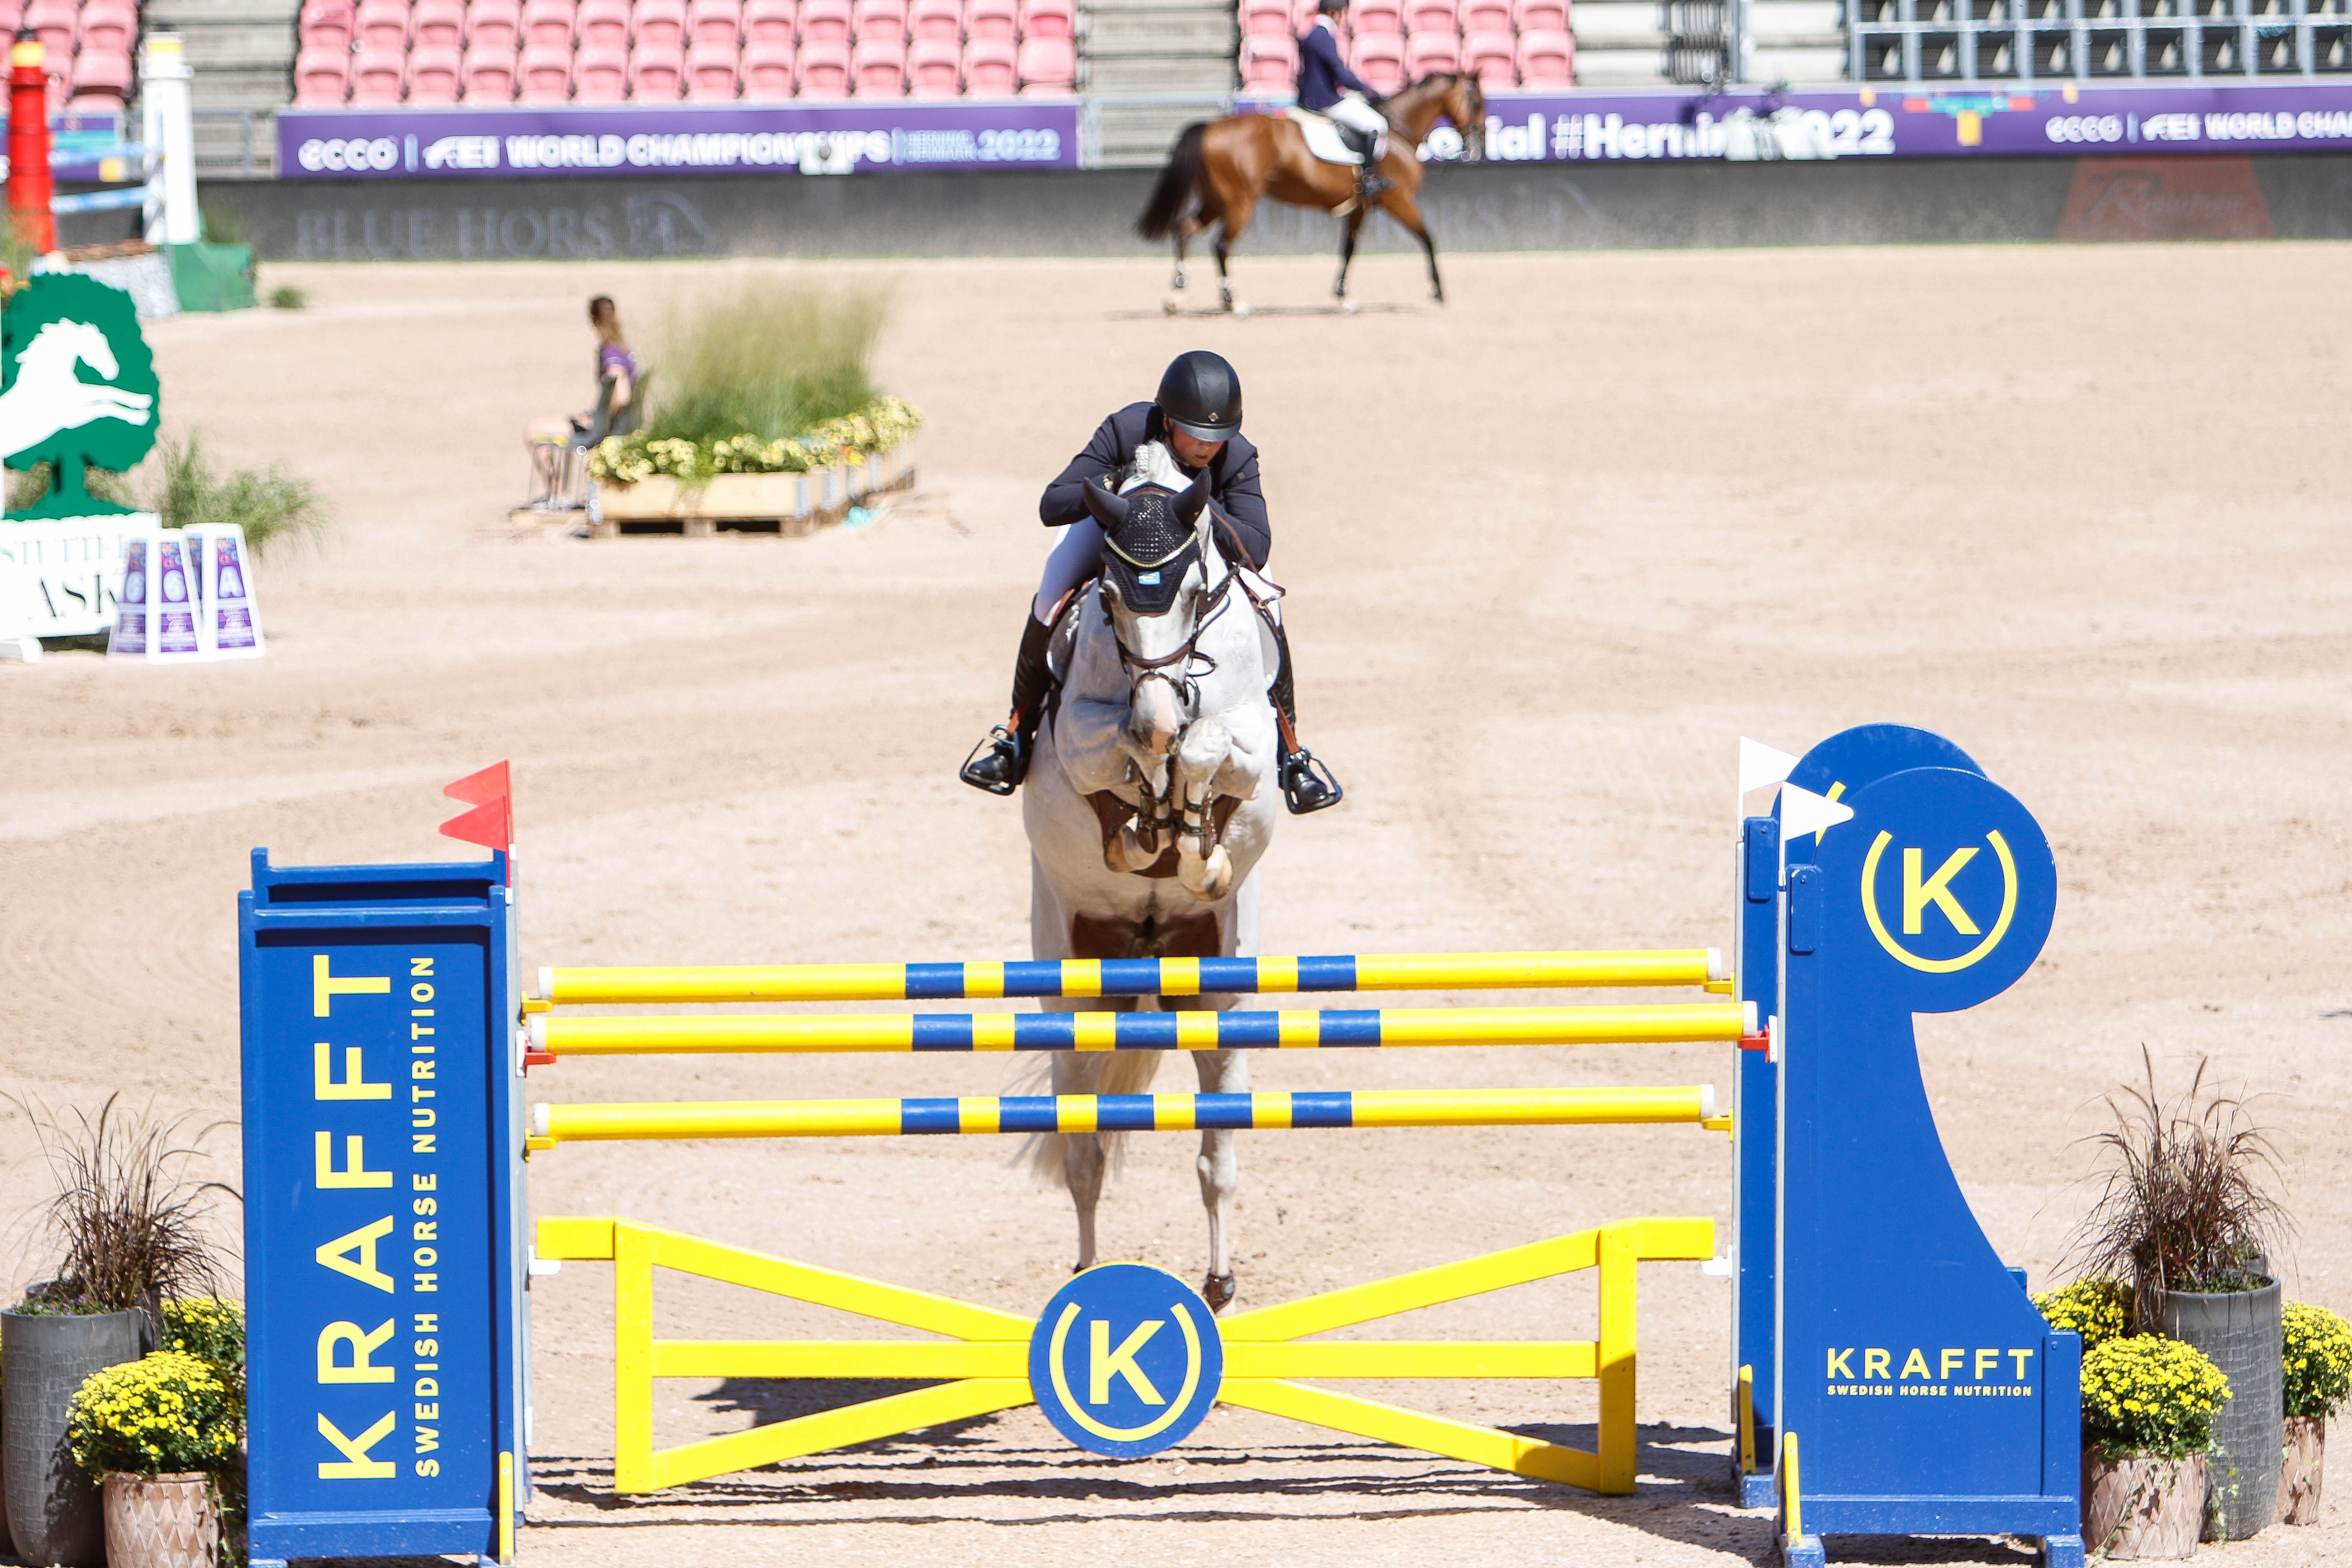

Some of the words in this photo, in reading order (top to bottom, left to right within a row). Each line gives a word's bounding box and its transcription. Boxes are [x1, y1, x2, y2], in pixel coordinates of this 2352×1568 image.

[505, 134, 627, 168] WORLD
[977, 128, 1061, 161] 2022
[2204, 111, 2296, 140] WORLD
[1903, 848, 1981, 935] K
[410, 957, 437, 1153] NUTRITION
[313, 954, 396, 1479] KRAFFT
[413, 1173, 438, 1292] HORSE
[414, 1313, 440, 1478] SWEDISH
[1089, 1320, 1167, 1405] K
[1827, 1348, 2034, 1380] KRAFFT
[1827, 1385, 1893, 1396] SWEDISH
[1900, 1385, 1947, 1396] HORSE
[1954, 1385, 2032, 1397] NUTRITION
